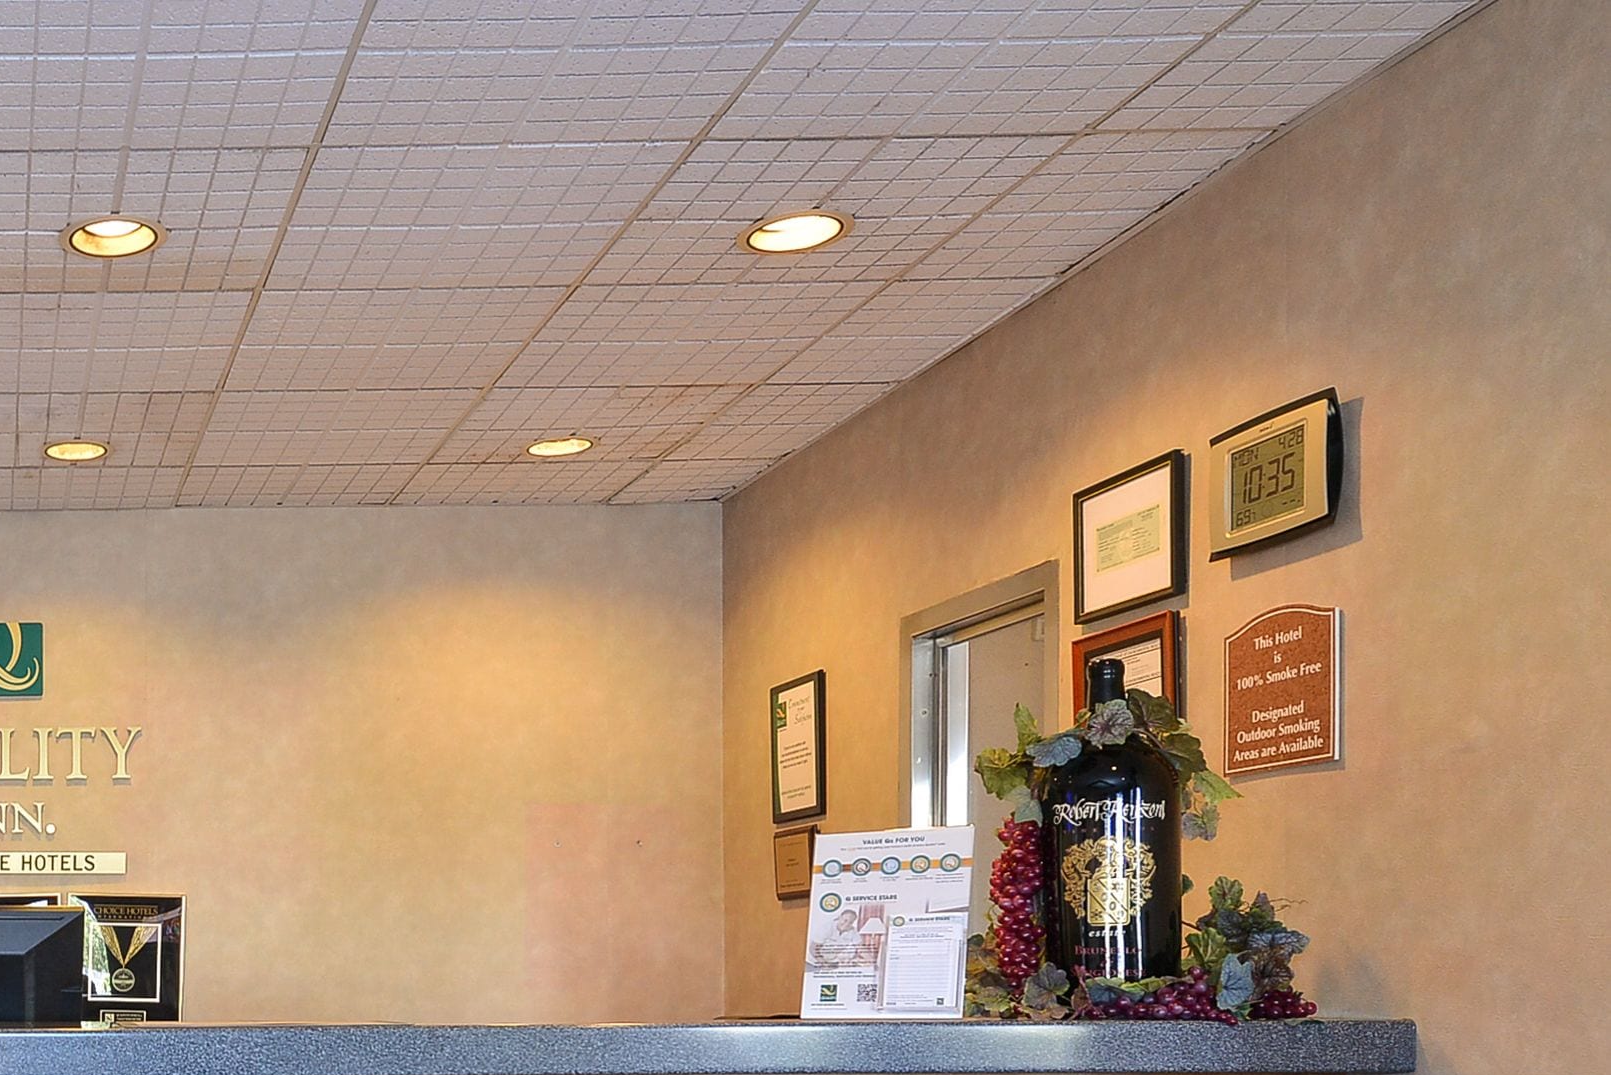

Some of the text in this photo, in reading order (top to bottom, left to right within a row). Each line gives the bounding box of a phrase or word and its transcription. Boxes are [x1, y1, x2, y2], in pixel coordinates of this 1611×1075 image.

[1243, 451, 1296, 504] 10:35
[1254, 625, 1302, 651] This Hotel
[1273, 651, 1282, 664] is
[1236, 662, 1322, 690] 100% Smoke Free
[1252, 700, 1304, 723] Designated
[1237, 718, 1321, 744] Outdoor Smoking
[1233, 735, 1324, 762] Areas are Available
[21, 854, 96, 872] HOTELS
[93, 906, 159, 915] CHOICE HOTELS
